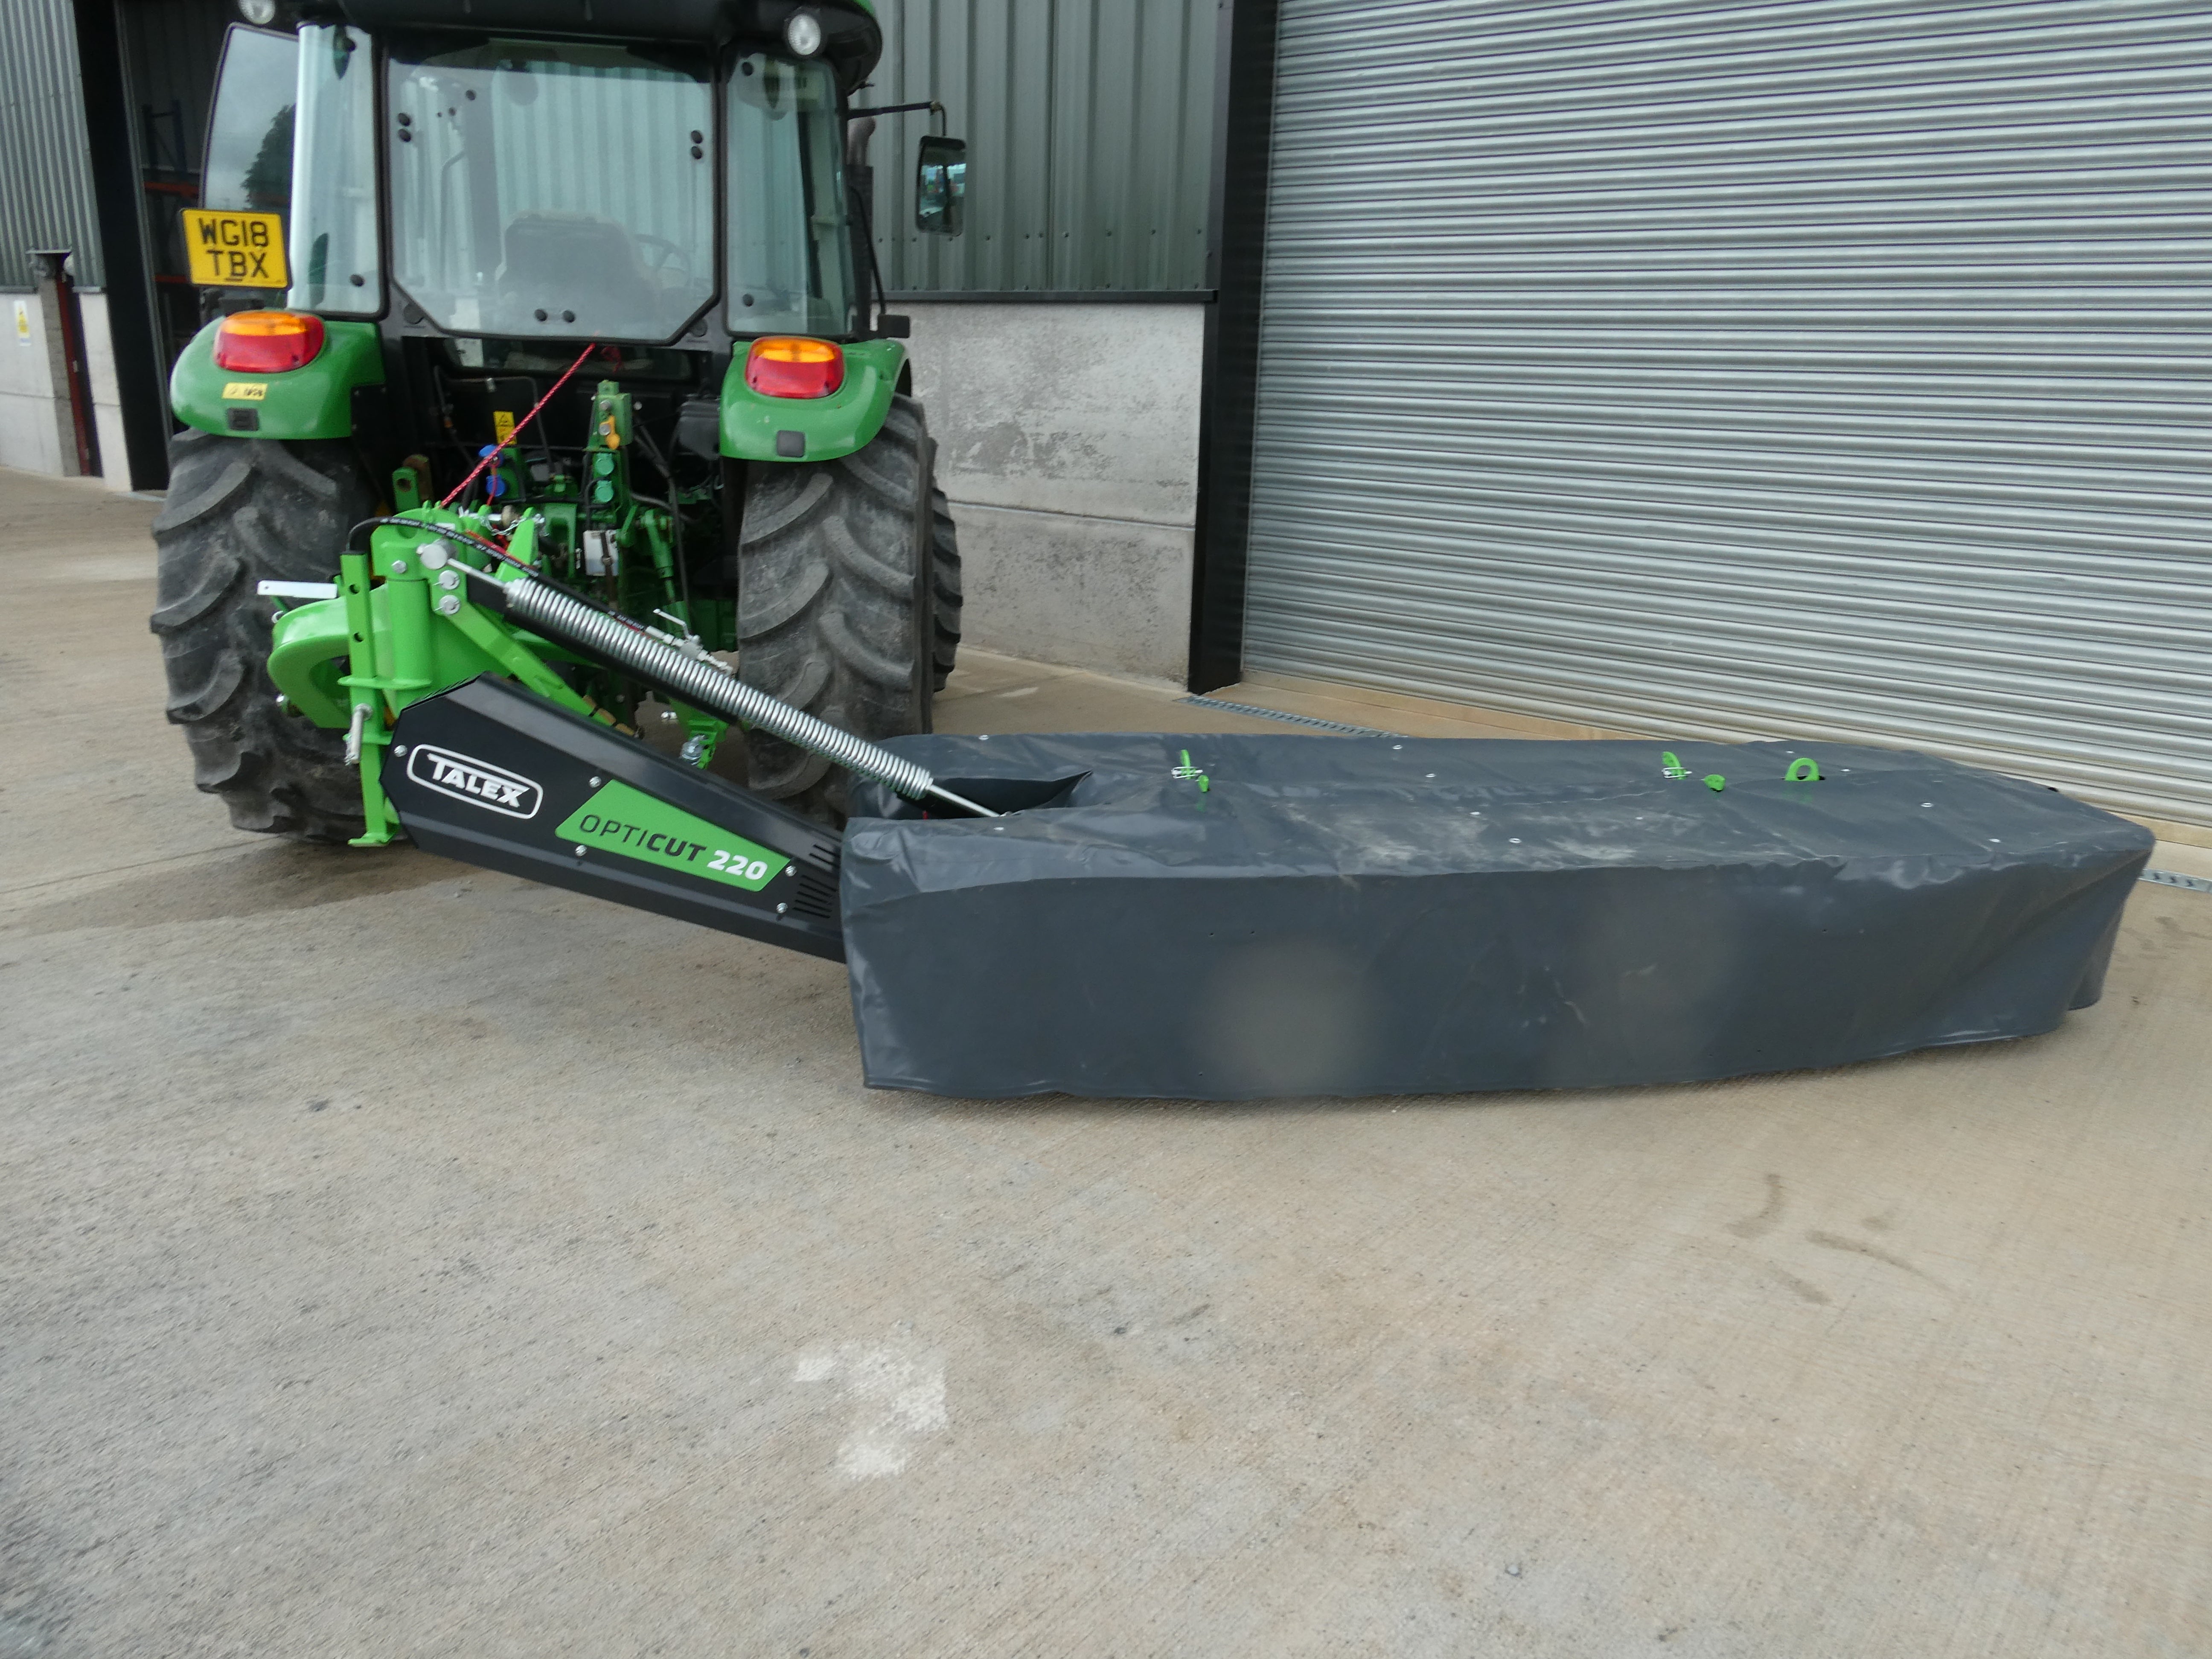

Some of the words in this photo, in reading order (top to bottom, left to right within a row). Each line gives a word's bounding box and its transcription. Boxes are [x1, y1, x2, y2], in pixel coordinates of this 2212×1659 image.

[198, 218, 269, 247] WG18
[206, 249, 269, 278] TBX
[427, 753, 530, 808] TALEX
[579, 814, 707, 862] OPTICUT
[707, 850, 768, 881] 220
